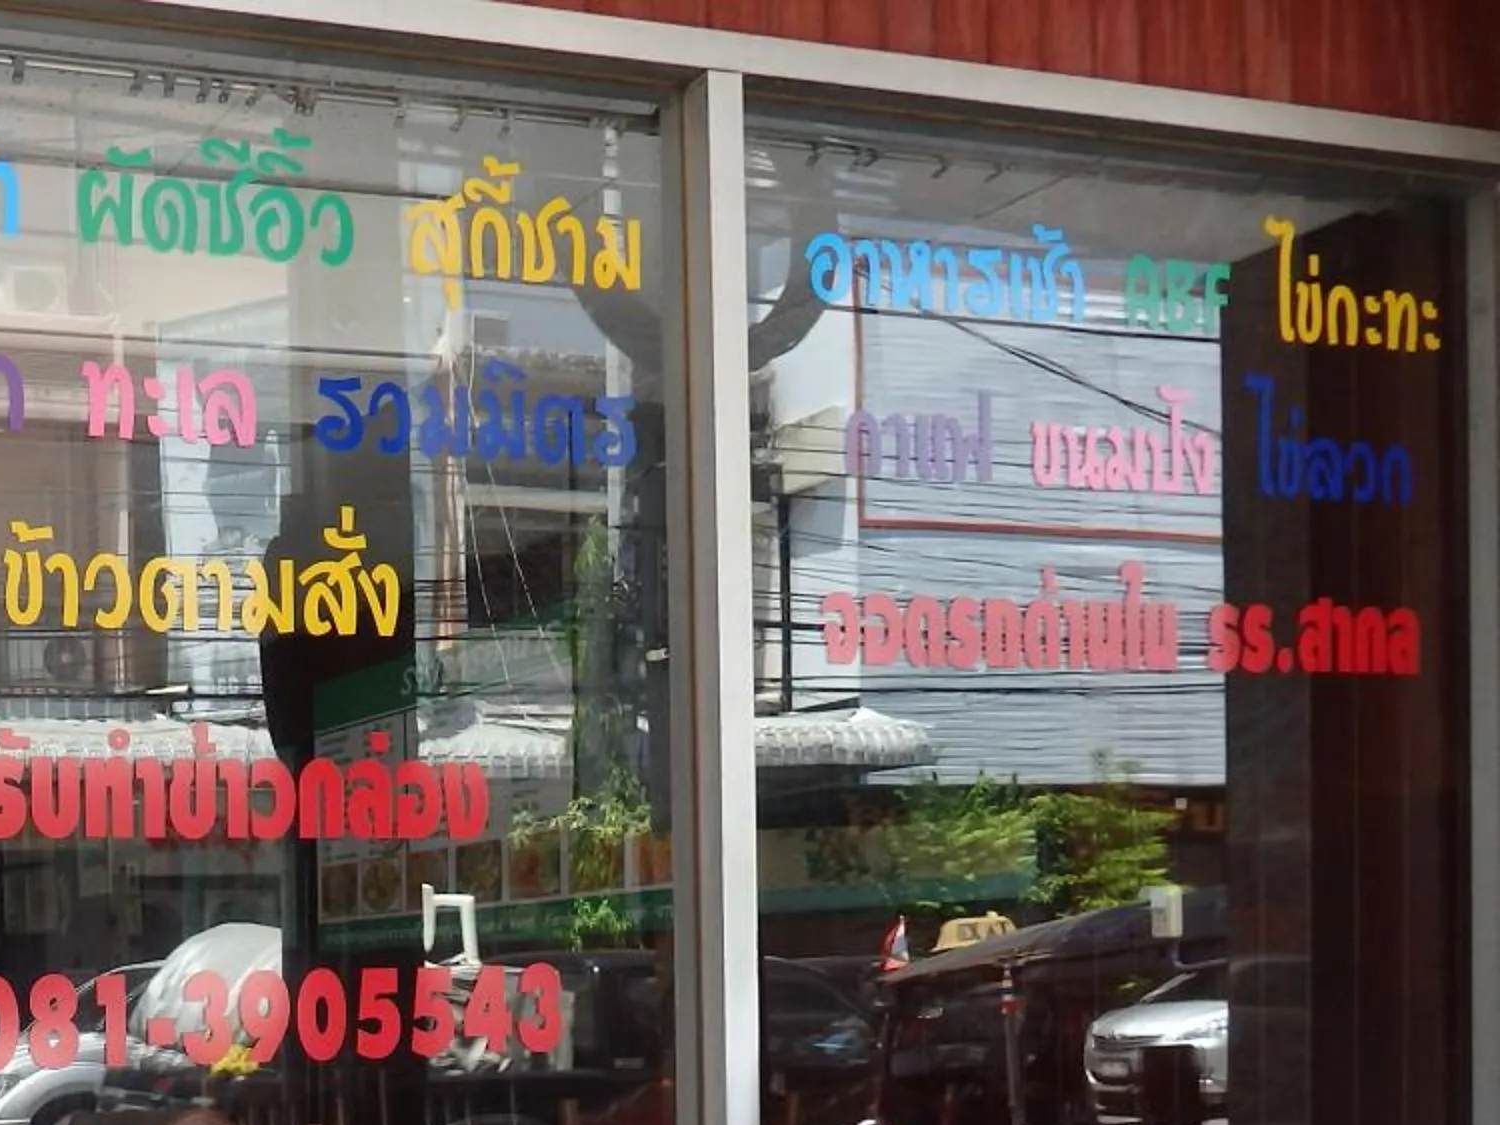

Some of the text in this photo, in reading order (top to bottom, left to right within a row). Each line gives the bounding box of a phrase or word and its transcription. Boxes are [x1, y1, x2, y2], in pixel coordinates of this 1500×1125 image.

[806, 223, 1085, 324] อาหารเช้า
[1264, 214, 1442, 352] ไข่กะทะ
[83, 360, 257, 448] ทะเล
[315, 359, 637, 467] รวมมิตร
[1030, 385, 1217, 495] ขนมปัง
[1244, 375, 1413, 507] ไข่ลวก
[4, 506, 400, 637] ข้าวตามสั่ง
